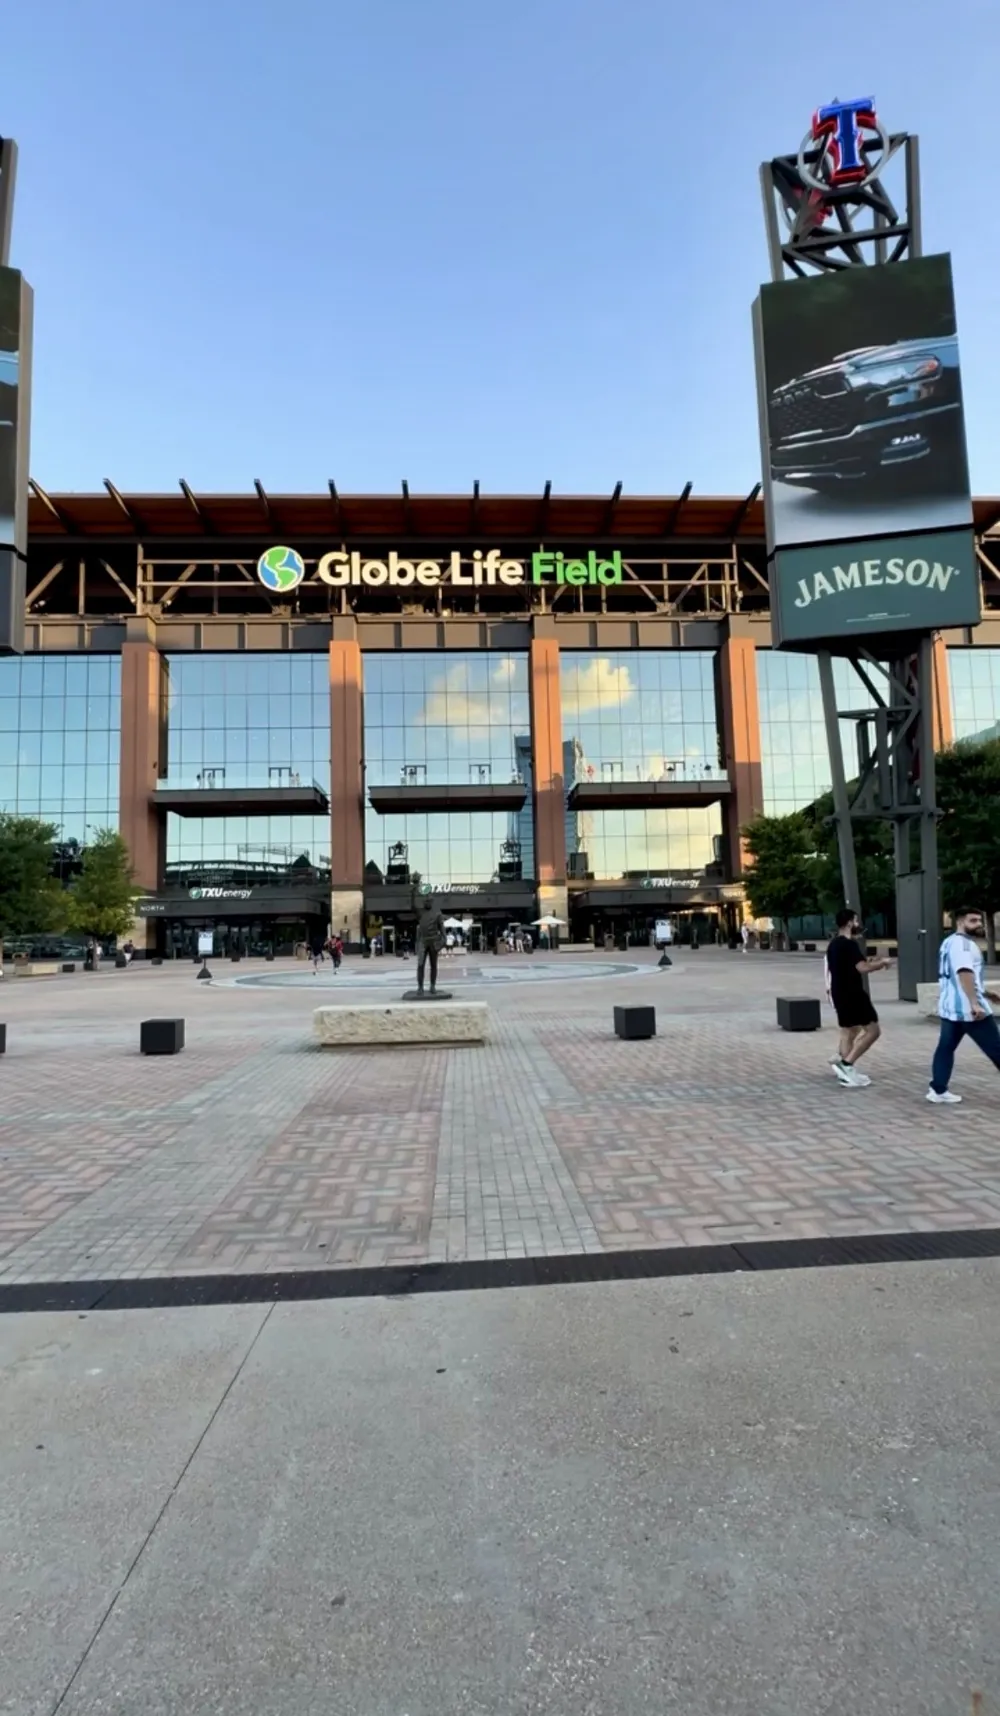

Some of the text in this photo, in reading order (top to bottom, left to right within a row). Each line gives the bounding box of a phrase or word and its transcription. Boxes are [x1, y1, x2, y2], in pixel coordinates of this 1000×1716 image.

[318, 549, 623, 586] Globe Life Field
[794, 557, 955, 608] JAMESON
